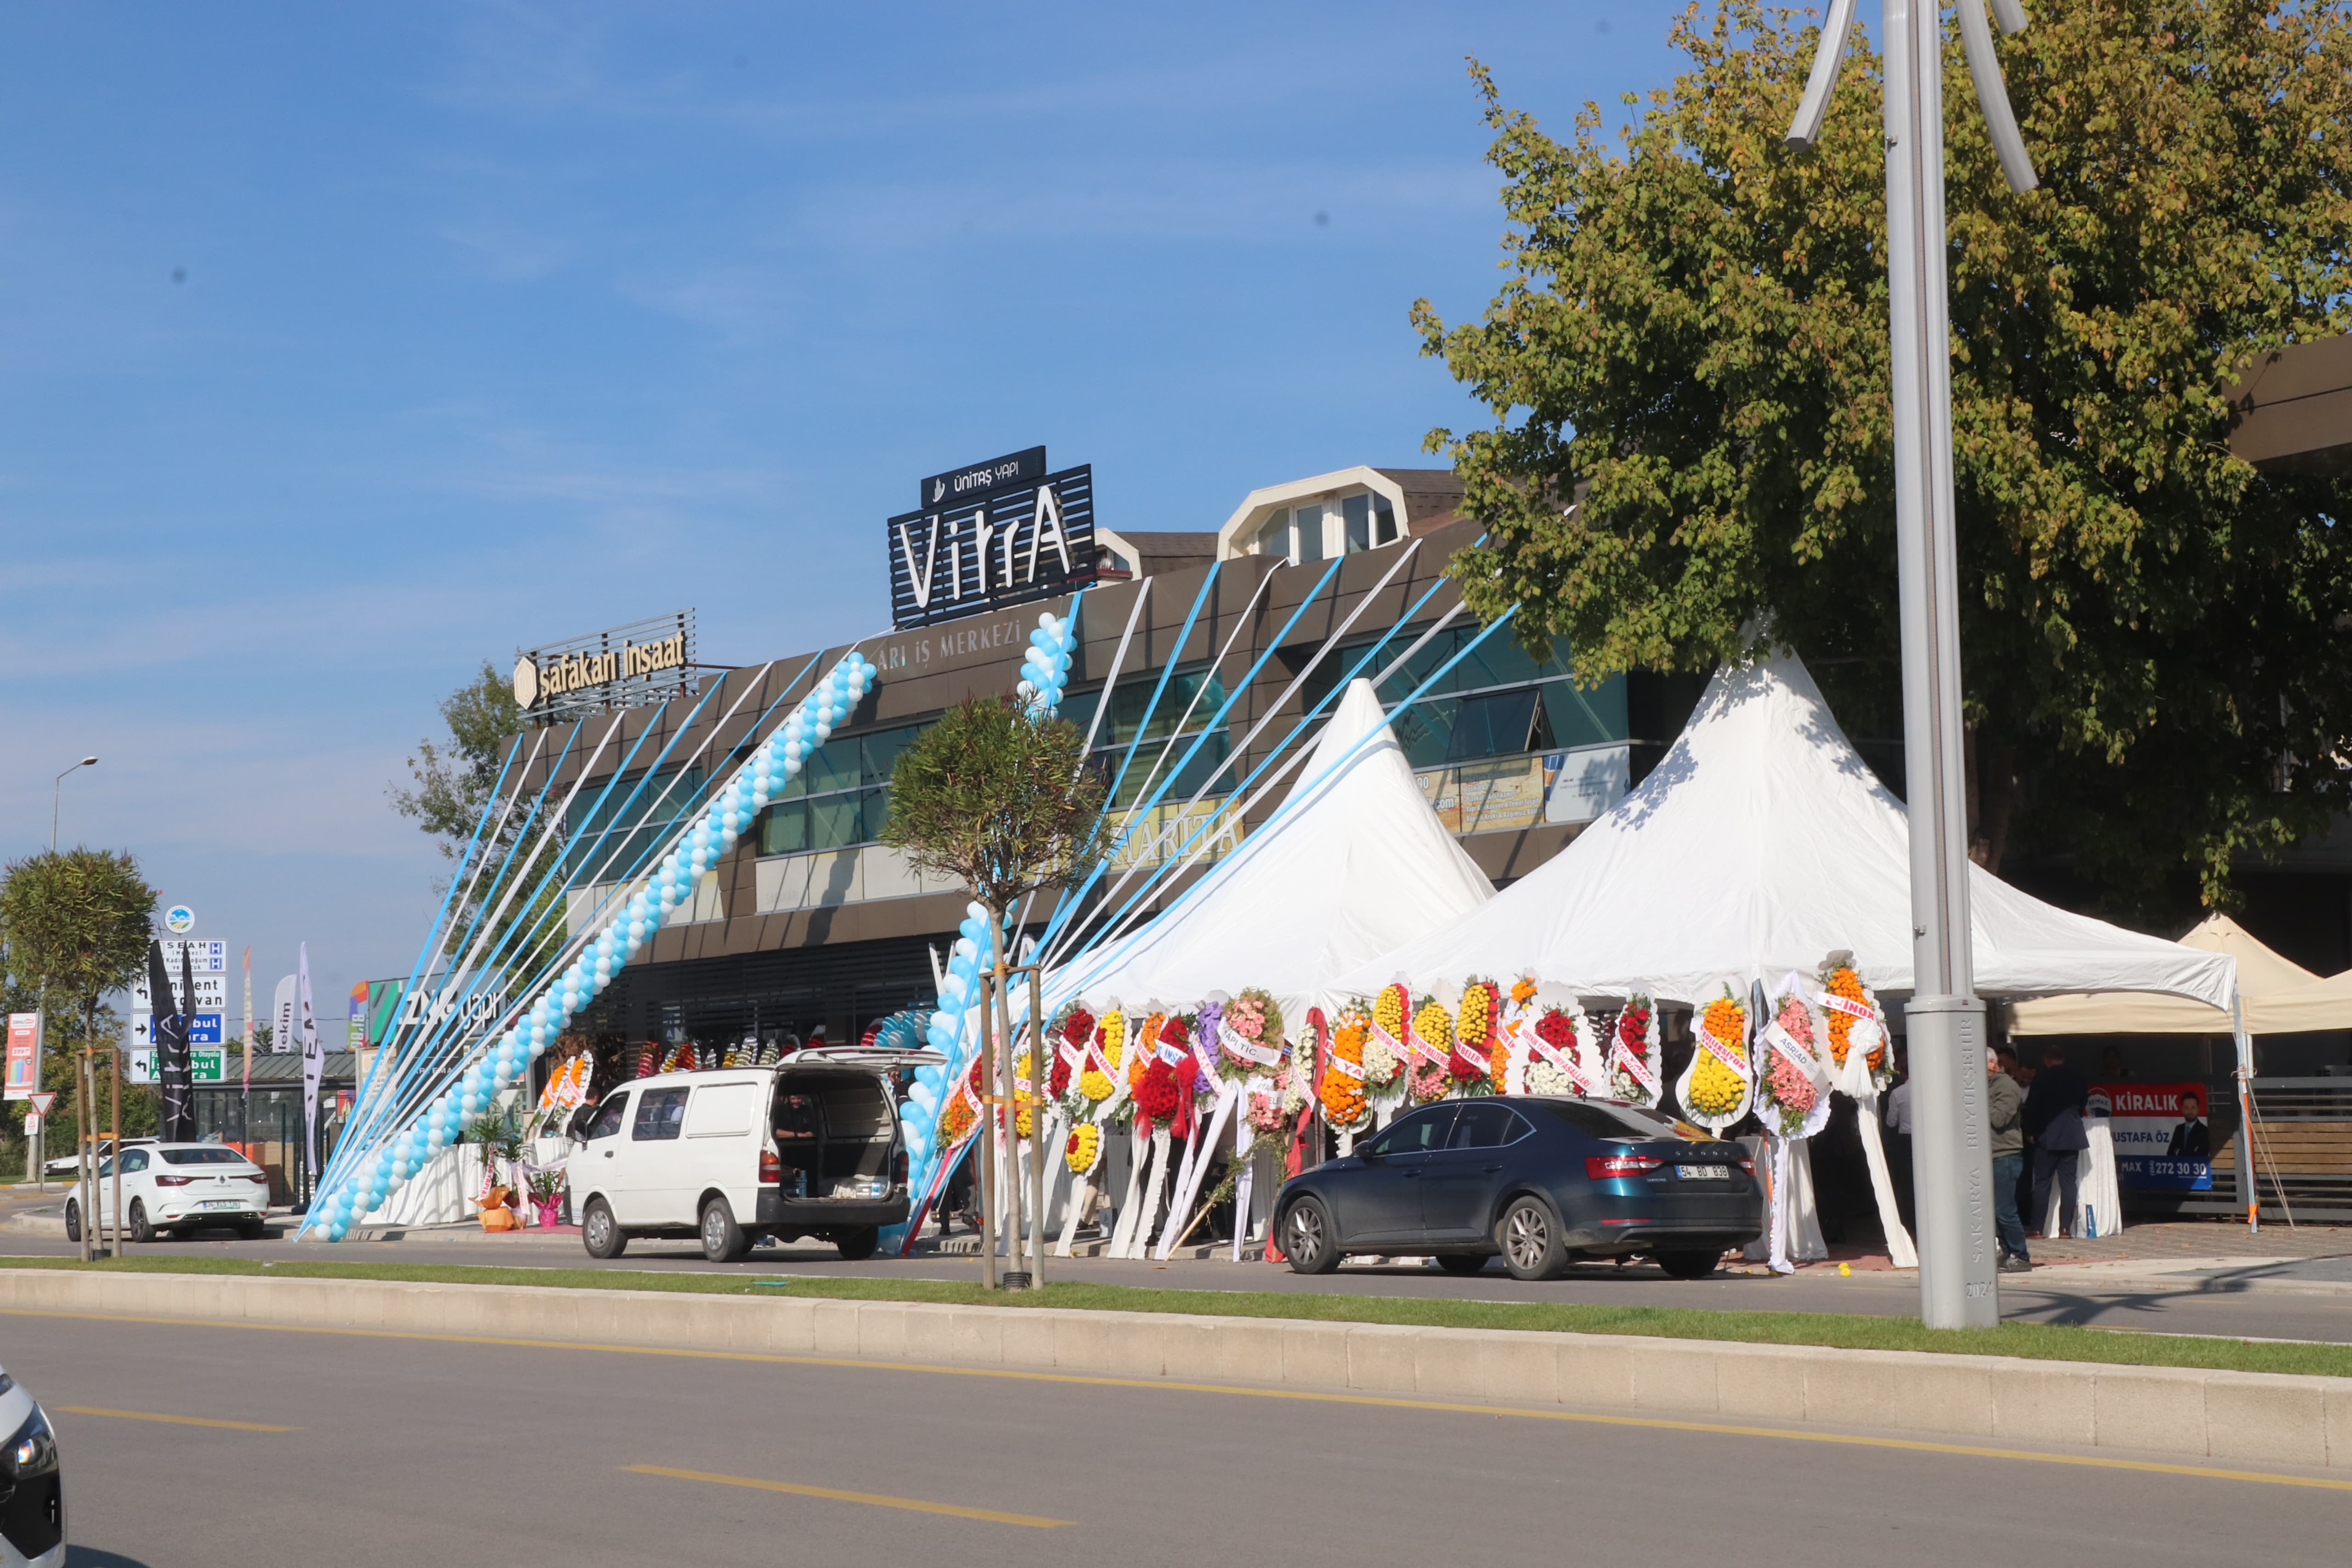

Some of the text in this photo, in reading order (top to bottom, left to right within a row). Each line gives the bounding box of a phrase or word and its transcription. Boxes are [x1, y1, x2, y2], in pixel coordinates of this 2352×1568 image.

[954, 461, 1018, 492] ÜNİTAŞ YAPI
[899, 485, 1070, 609] VitrA
[916, 640, 930, 668] İŞ
[940, 620, 1021, 658] MERKEZİ
[170, 979, 218, 991] nient
[1461, 1047, 1481, 1064] BELER
[2115, 1091, 2179, 1111] KİRALIK
[1959, 1018, 1984, 1263] SAKARYA BÜYÜKŞEHİR
[2113, 1130, 2170, 1143] USTAFA ÖZ
[1680, 1166, 1691, 1177] 54
[1712, 1166, 1728, 1177] 838
[2155, 1163, 2174, 1174] 272
[2177, 1163, 2190, 1175] 30
[2193, 1163, 2206, 1176] 30
[1966, 1281, 1994, 1298] 2024
